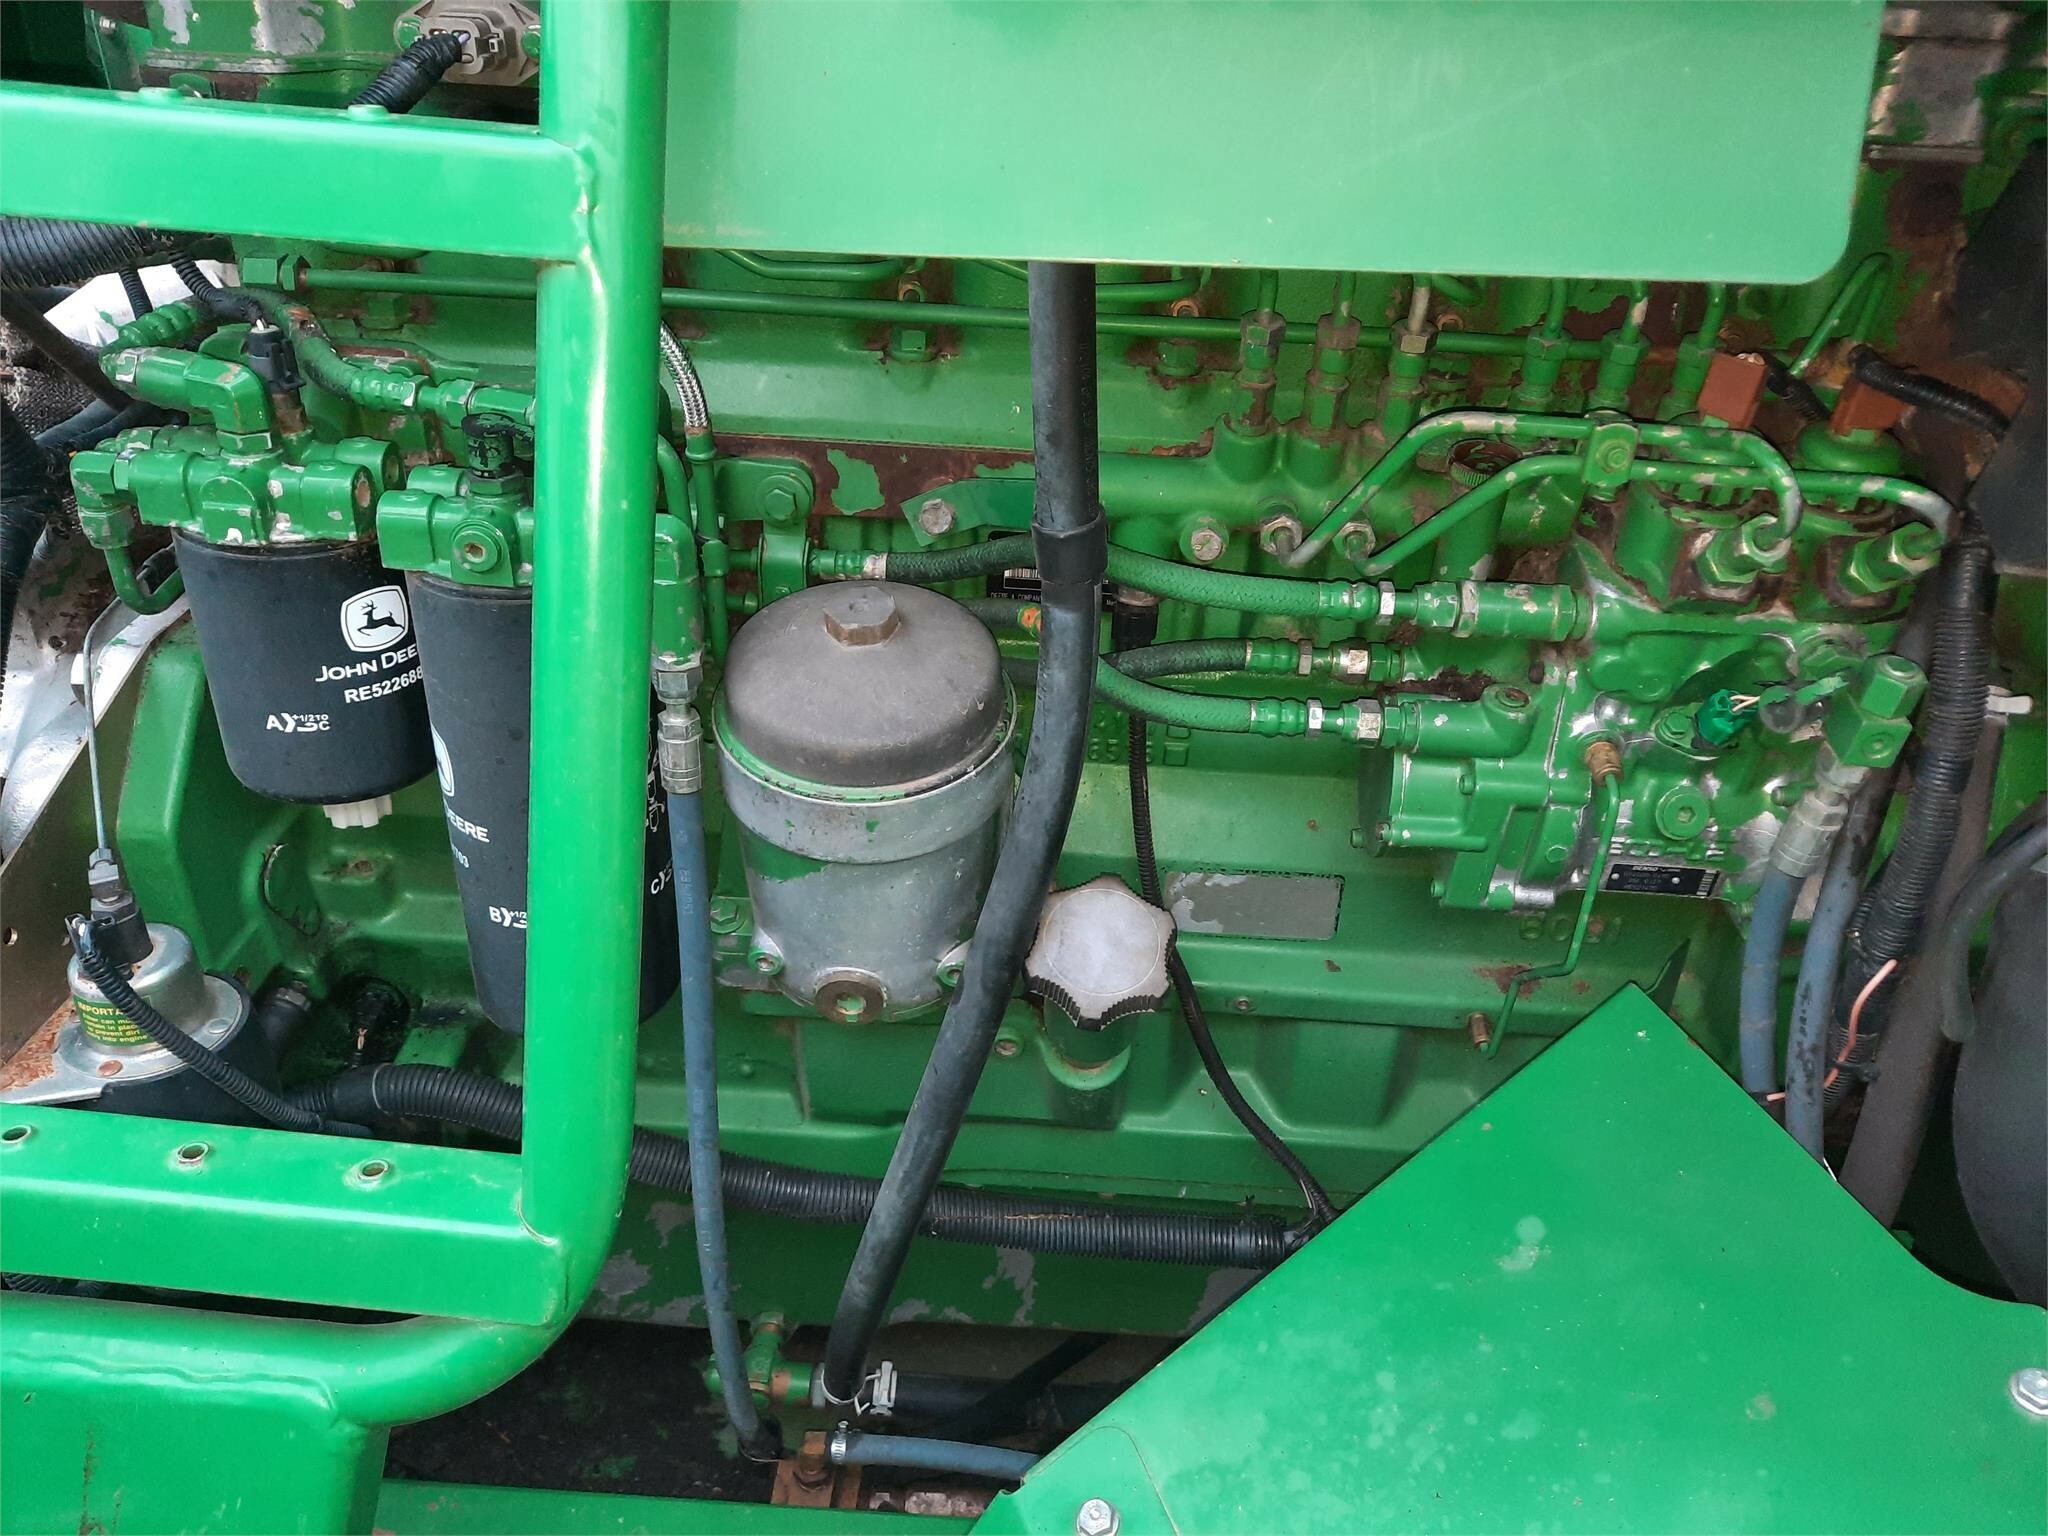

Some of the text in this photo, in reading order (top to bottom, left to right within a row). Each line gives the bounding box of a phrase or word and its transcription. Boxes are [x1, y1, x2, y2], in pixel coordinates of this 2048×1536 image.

[315, 643, 418, 682] JOHN DEE
[344, 665, 424, 703] RE522688
[77, 1001, 124, 1016] IMPORTA
[118, 1024, 139, 1032] plac
[125, 1029, 140, 1037] dirt
[118, 1034, 148, 1043] engine
